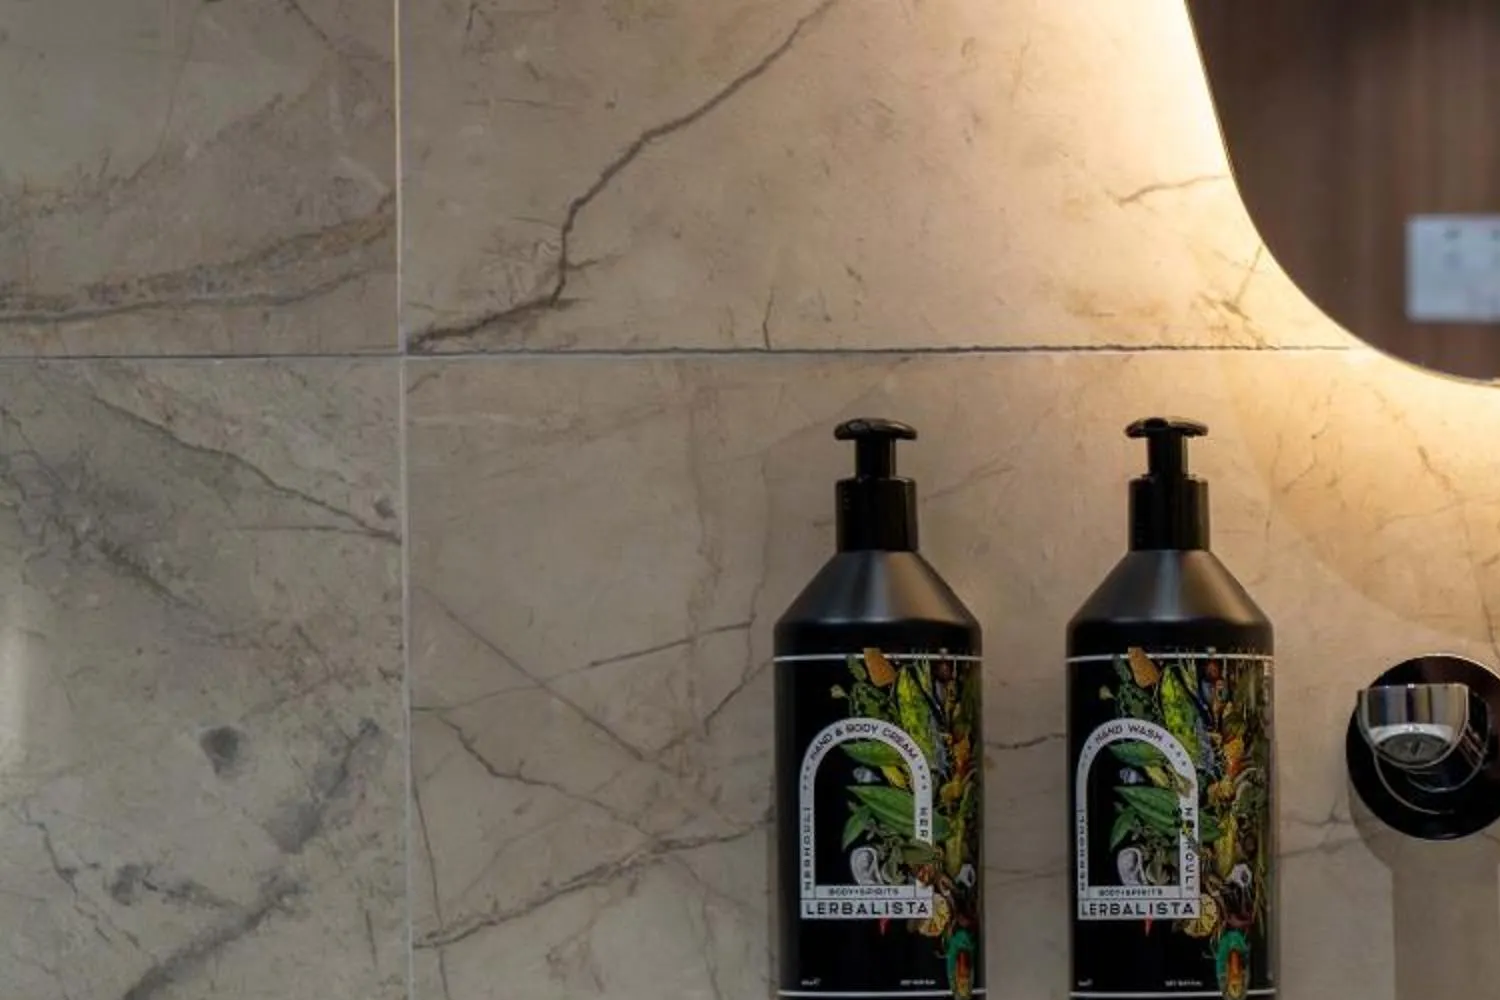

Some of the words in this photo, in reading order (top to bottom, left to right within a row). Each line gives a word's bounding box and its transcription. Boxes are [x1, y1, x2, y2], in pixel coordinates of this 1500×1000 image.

[845, 722, 879, 736] BODY
[882, 723, 919, 761] CREAM
[1094, 724, 1124, 744] HAND
[1128, 724, 1164, 742] WASH
[805, 901, 929, 915] LERBALISTA
[1080, 901, 1195, 916] LERBALISTA
